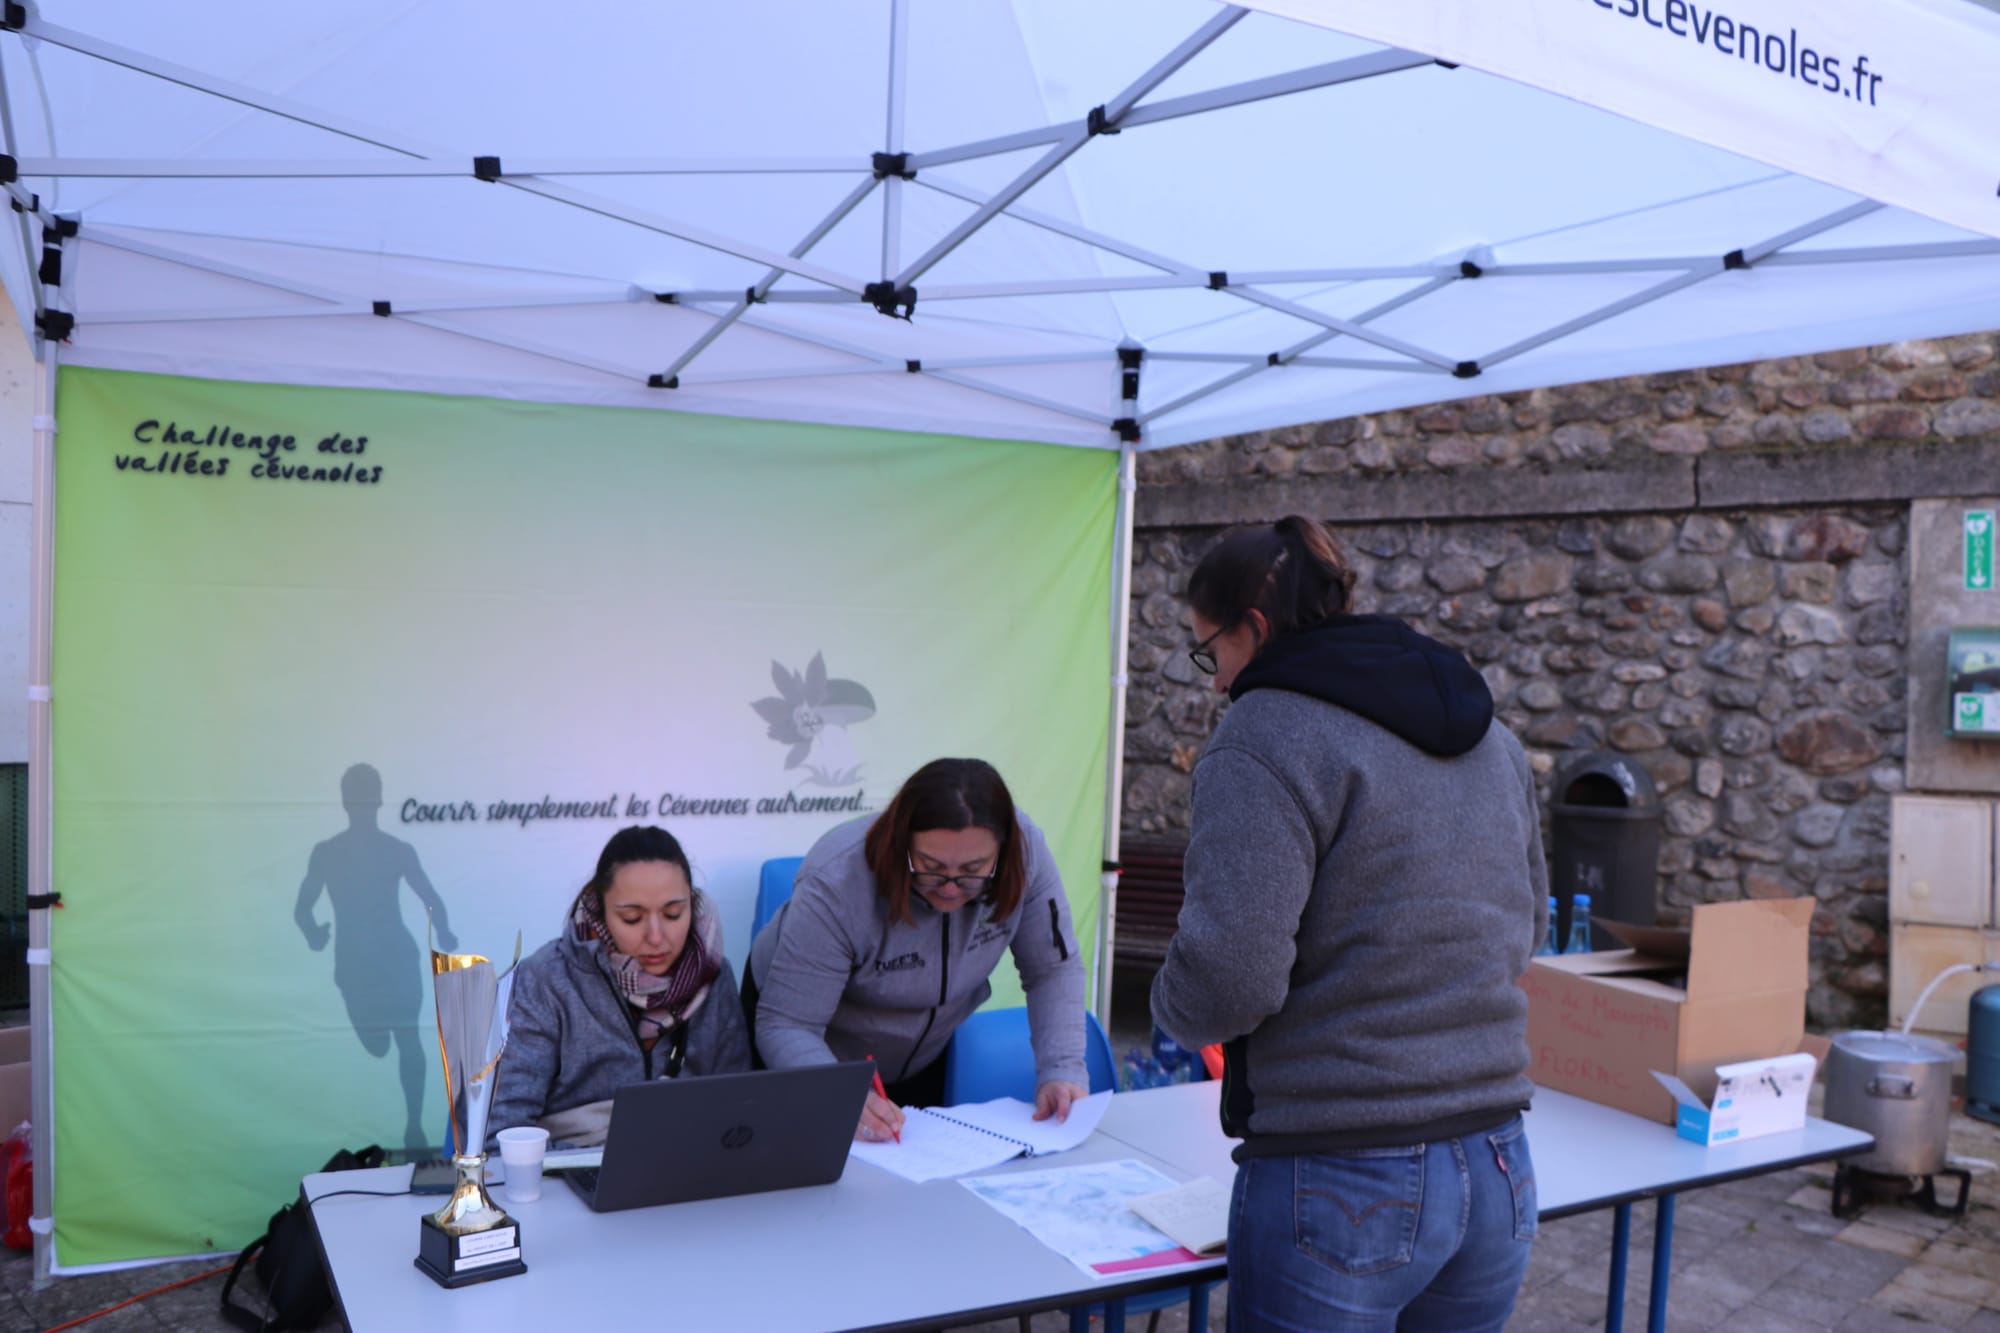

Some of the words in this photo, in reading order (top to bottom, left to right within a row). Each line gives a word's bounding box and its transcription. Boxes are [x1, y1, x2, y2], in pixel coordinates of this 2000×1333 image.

[134, 420, 297, 458] Challenge
[317, 433, 368, 454] des
[115, 451, 230, 476] vallées
[250, 456, 383, 484] cévenoles
[400, 798, 478, 823] Courir
[625, 792, 650, 817] les
[657, 792, 749, 816] Cévennes
